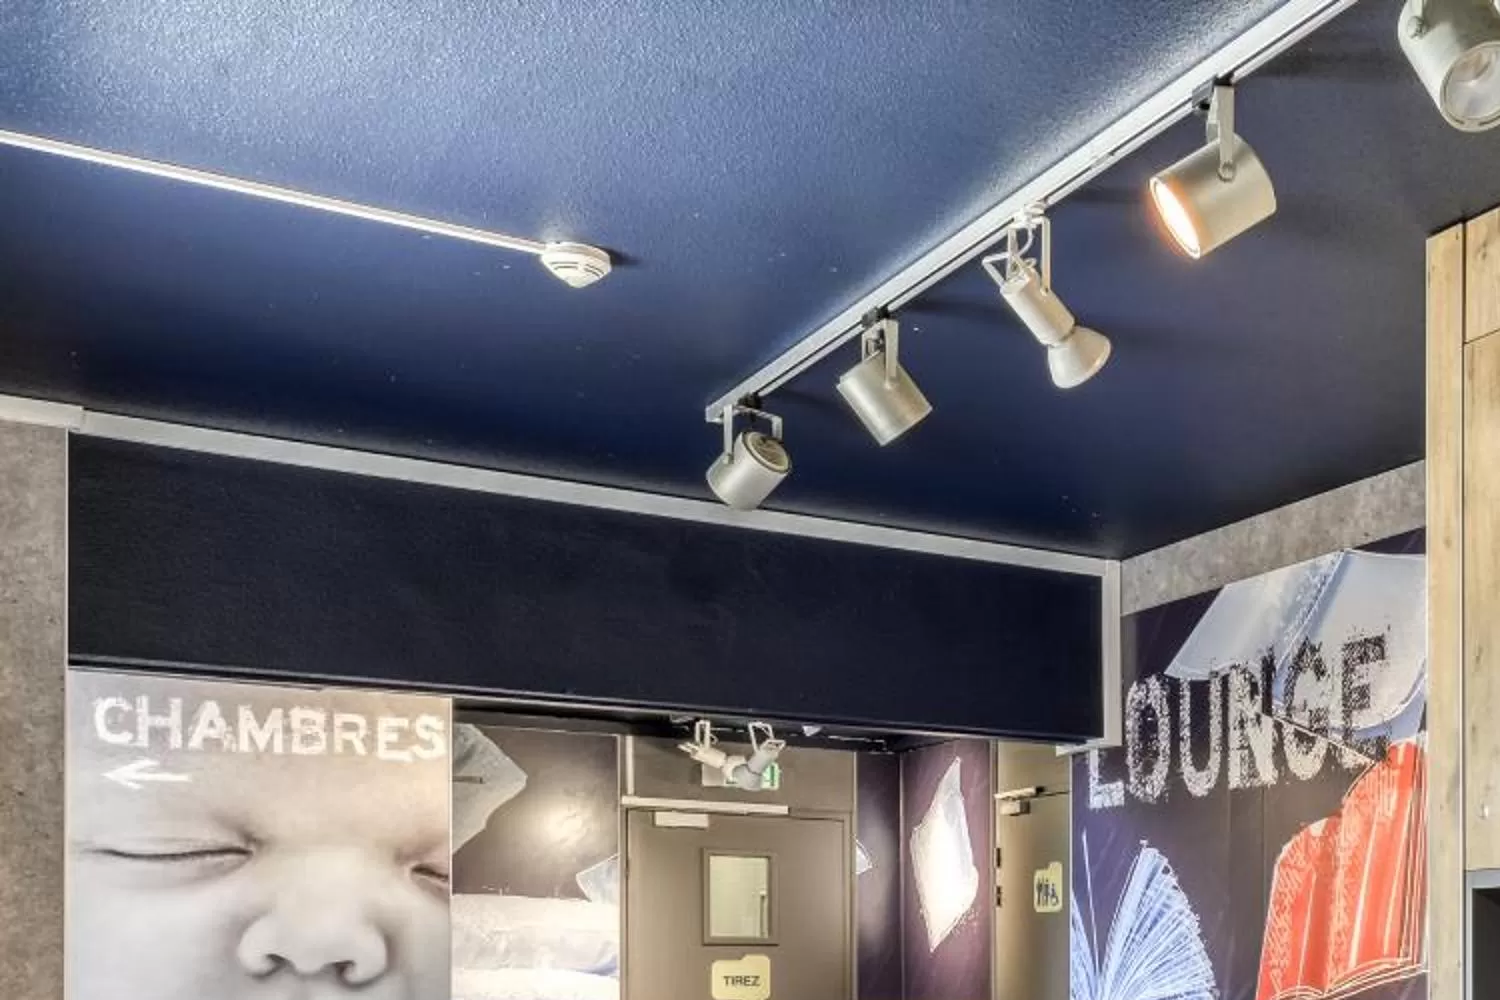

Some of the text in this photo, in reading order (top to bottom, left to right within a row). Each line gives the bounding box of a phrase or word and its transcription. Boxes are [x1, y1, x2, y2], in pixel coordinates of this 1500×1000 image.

[93, 695, 448, 762] CHAMBRES
[1088, 632, 1394, 810] LOUNGE
[723, 975, 761, 987] TIREZ
